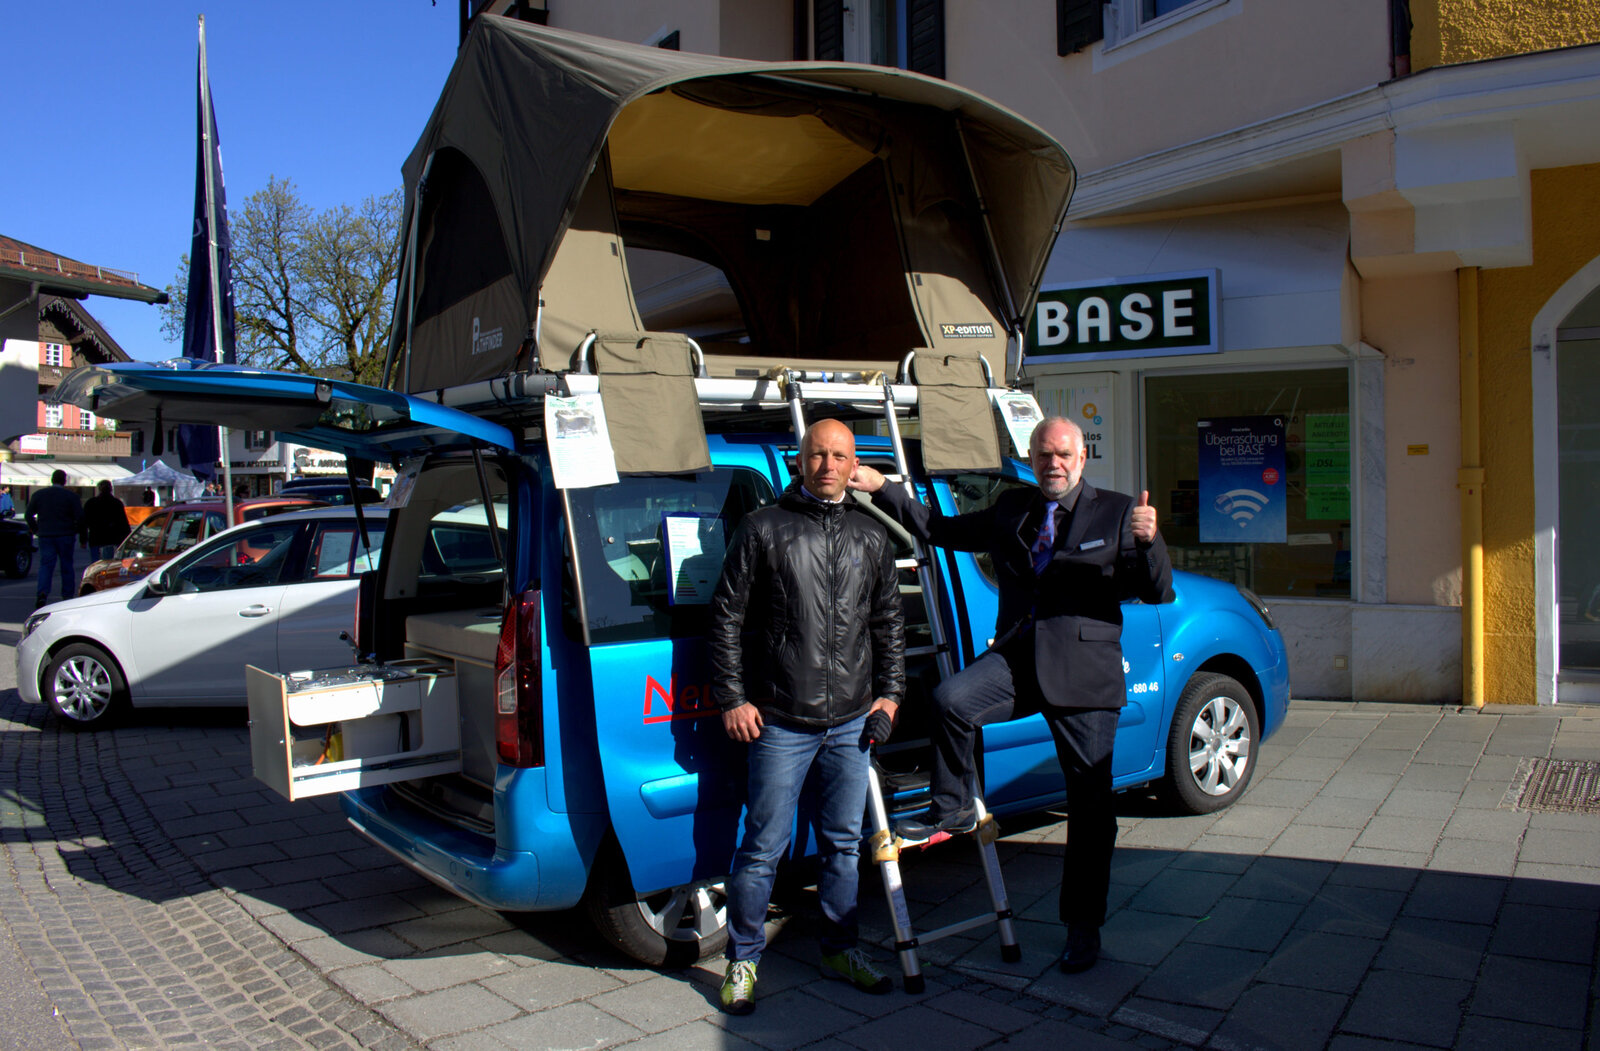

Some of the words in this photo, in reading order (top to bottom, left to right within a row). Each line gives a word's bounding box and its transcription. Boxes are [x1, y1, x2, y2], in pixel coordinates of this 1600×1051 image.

[1037, 288, 1194, 346] BASE
[1205, 432, 1278, 446] Überraschung
[1220, 444, 1236, 456] bei
[1238, 444, 1264, 456] BASE
[1133, 683, 1147, 693] 680
